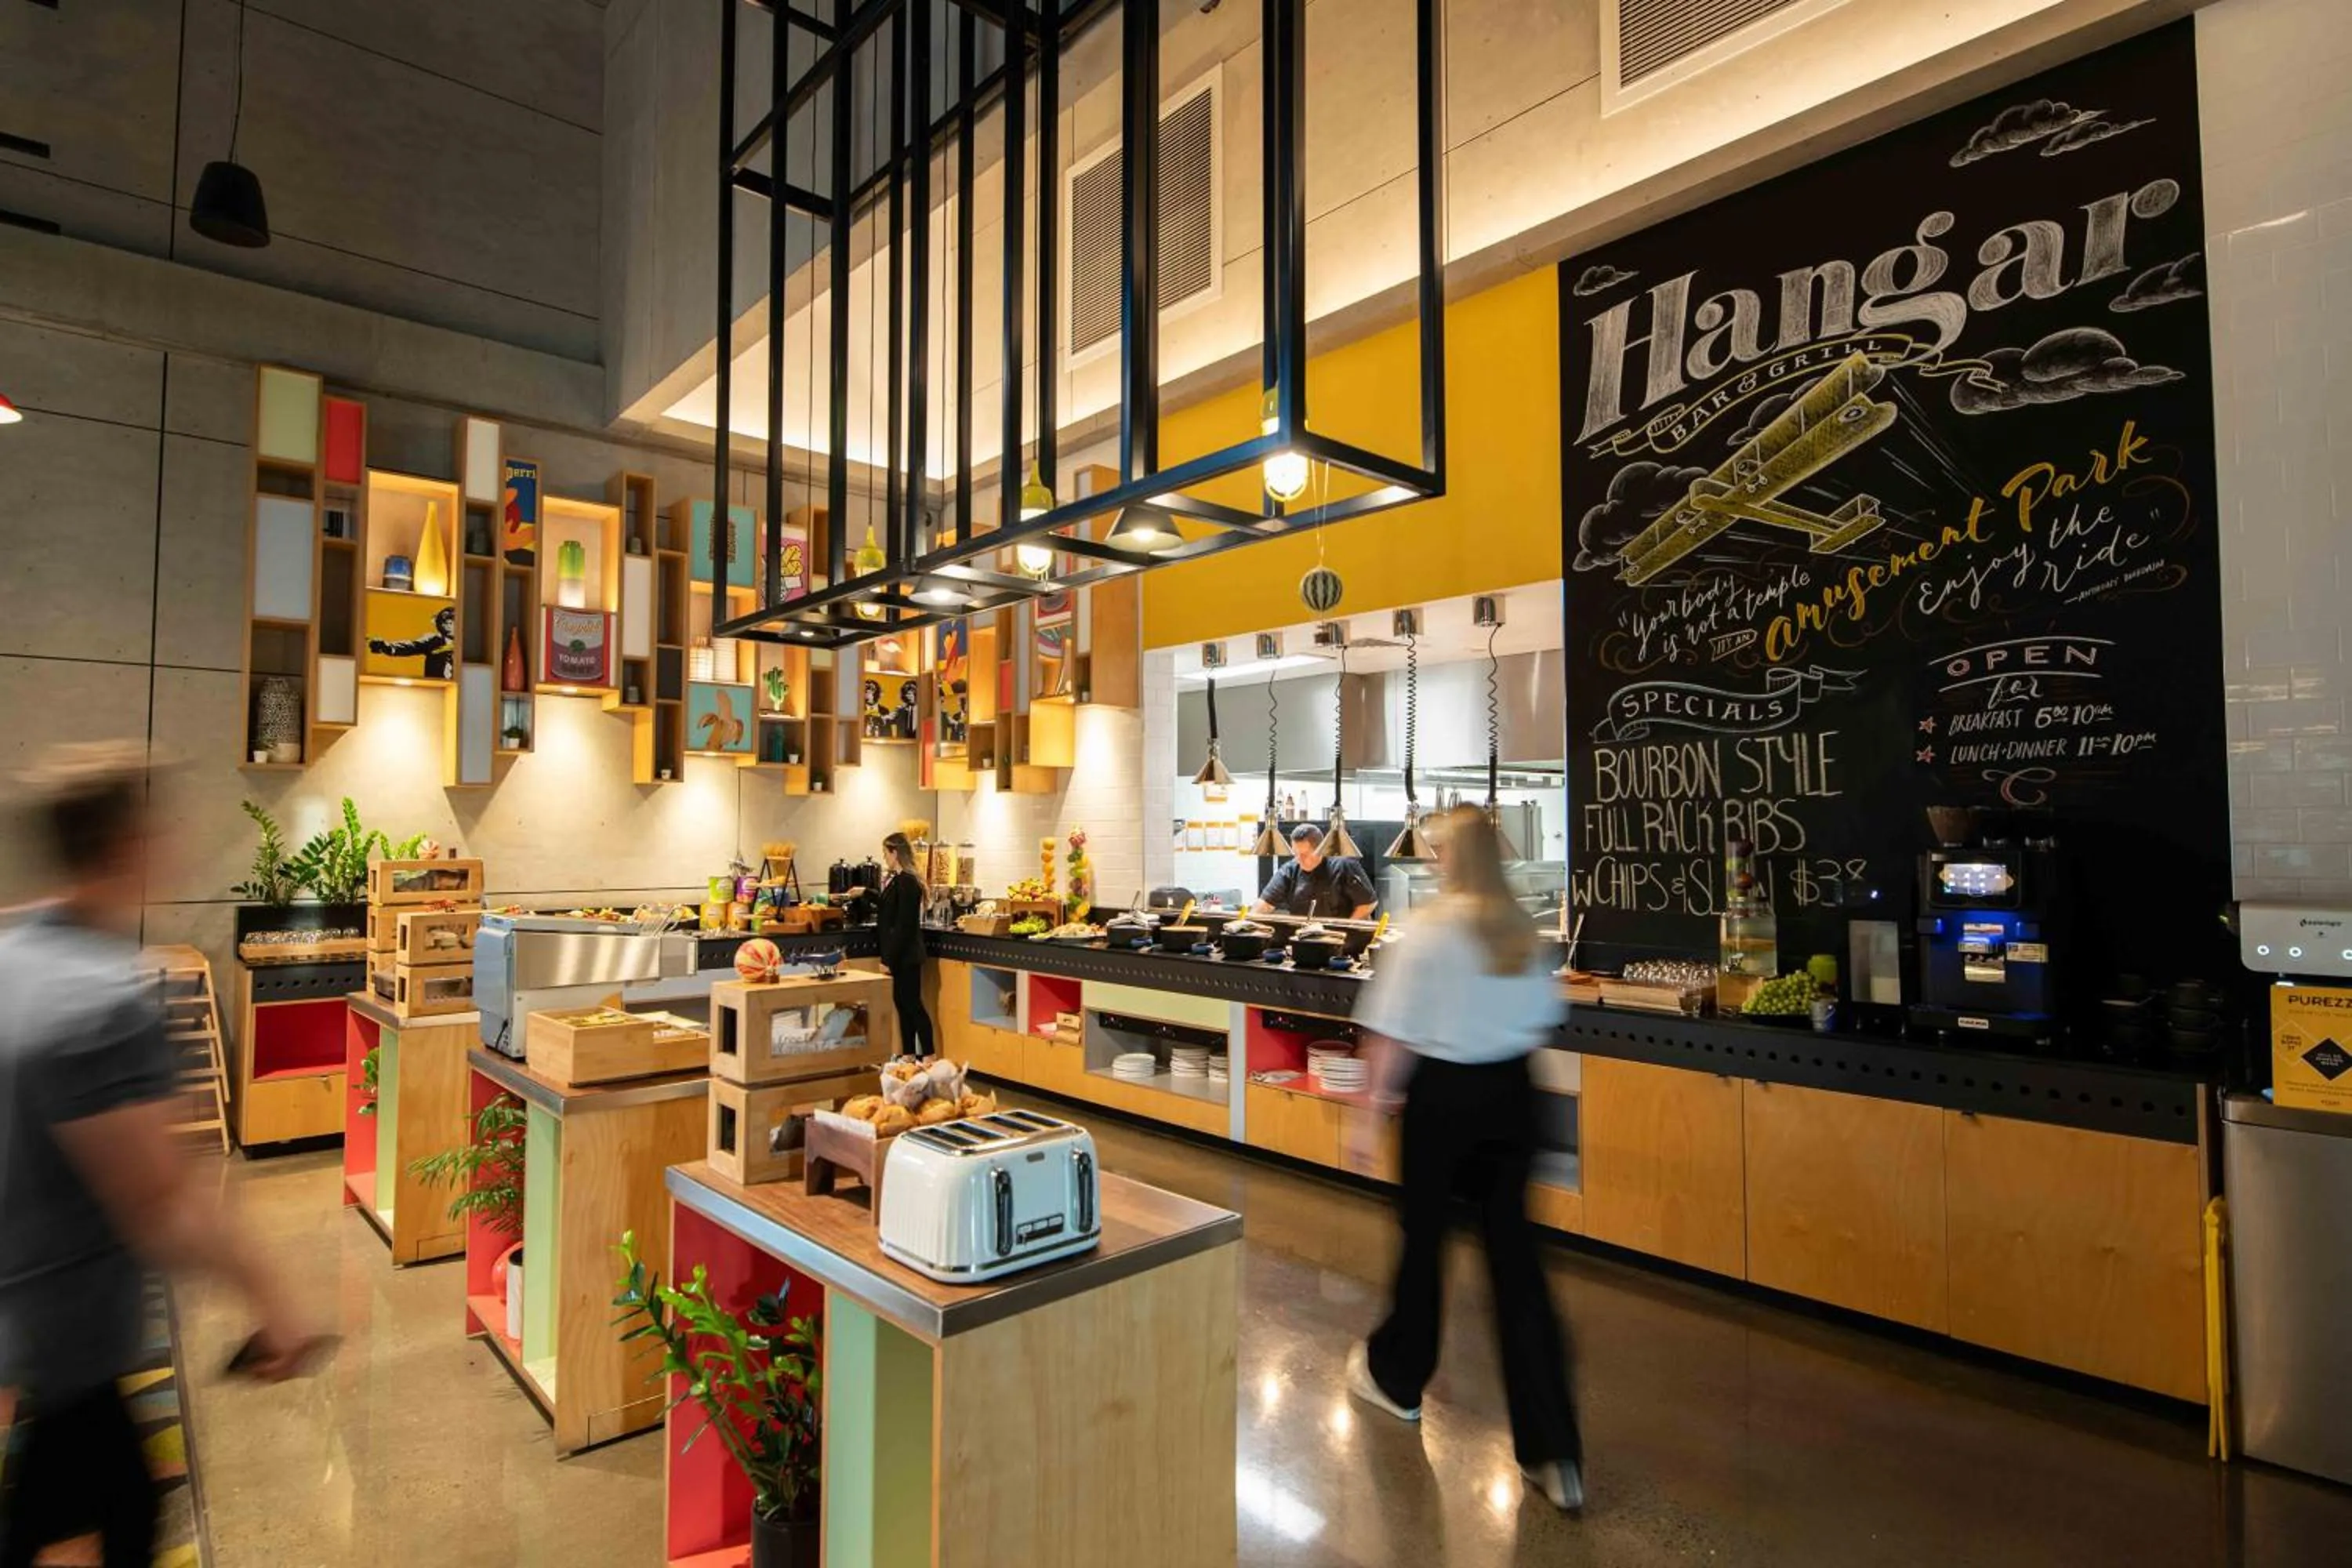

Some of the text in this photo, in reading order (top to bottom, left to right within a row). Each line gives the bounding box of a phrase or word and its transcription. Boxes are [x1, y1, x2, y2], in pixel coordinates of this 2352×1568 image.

[1573, 179, 2180, 445] Hangar
[1671, 340, 1882, 443] BAR & GRILL
[2001, 420, 2152, 532] Park
[1918, 503, 2114, 615] Enjoy the
[1664, 564, 1811, 663] is not a temple
[1682, 574, 1745, 620] body
[559, 654, 596, 666] TOMATO
[1947, 645, 2098, 677] OPEN
[1621, 691, 1784, 720] SPECIALS
[1987, 675, 2043, 710] for
[1948, 707, 2025, 736] BREAKFAST
[1594, 731, 1843, 803] BOURBON STYLE
[1584, 798, 1806, 855] FULL RACK RIBS
[1595, 856, 1669, 911] CHIPS
